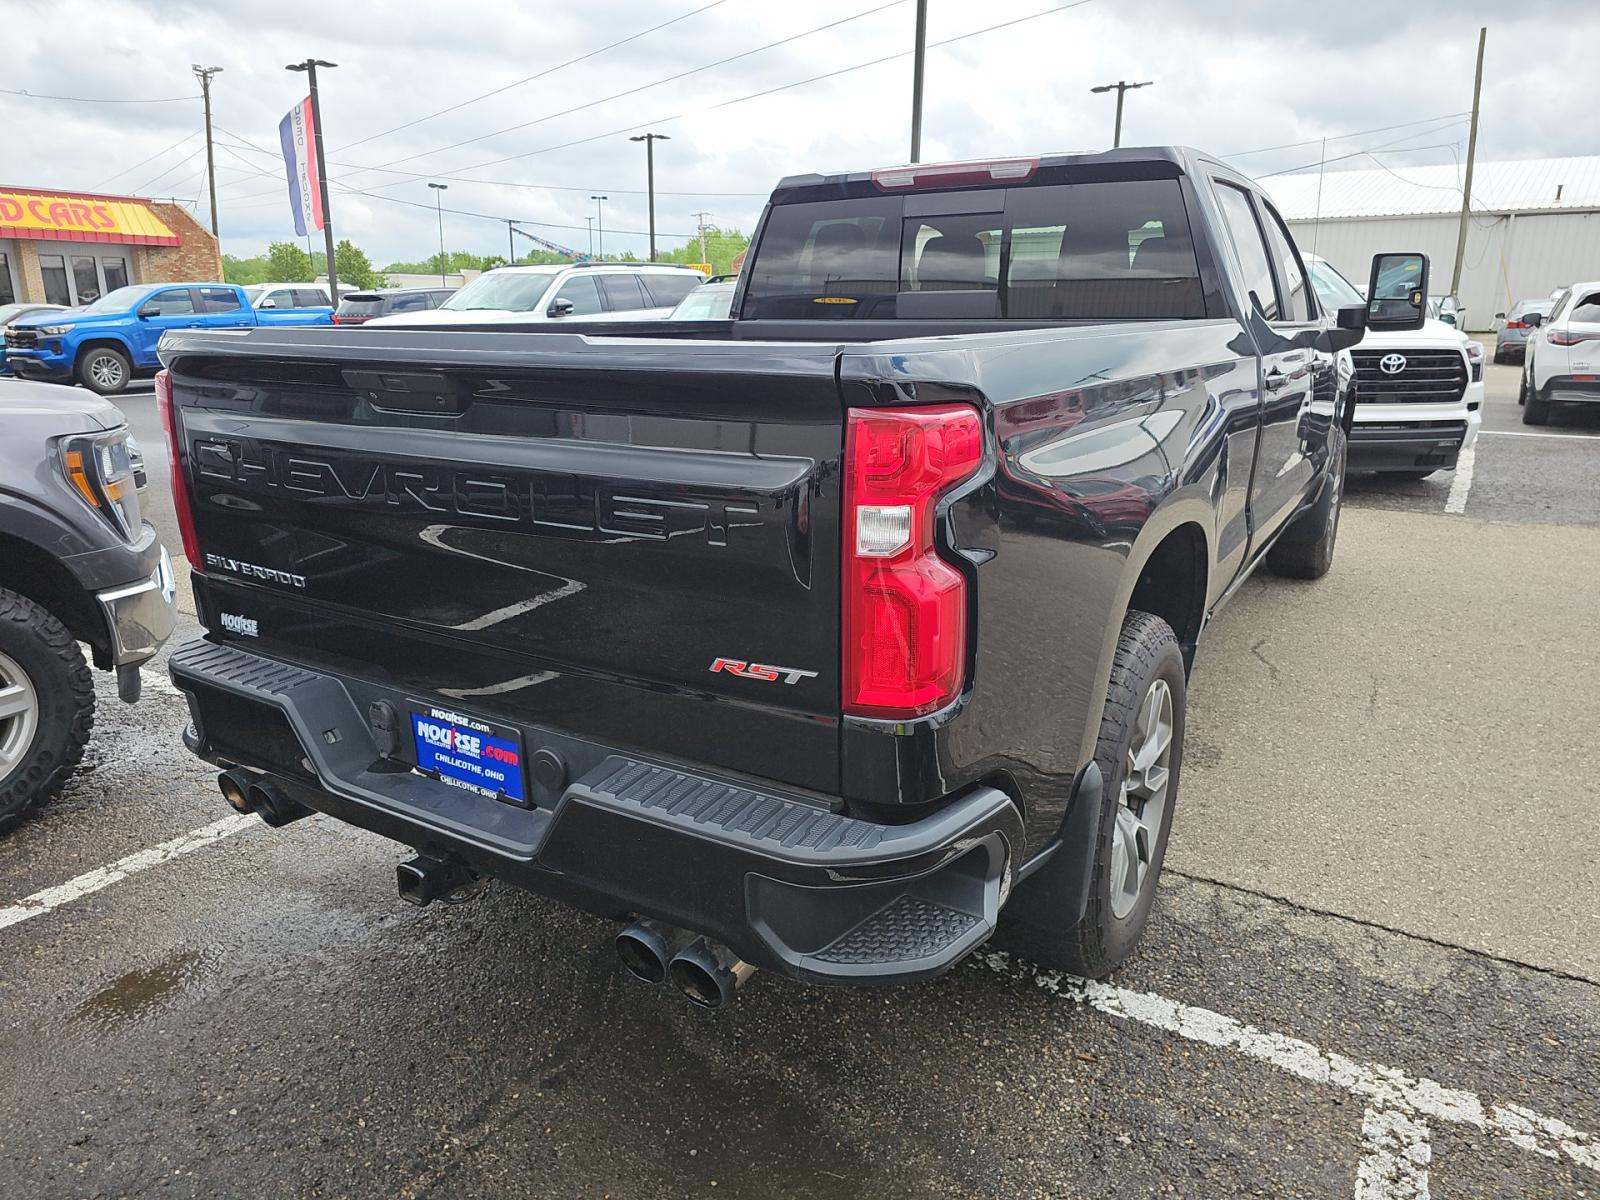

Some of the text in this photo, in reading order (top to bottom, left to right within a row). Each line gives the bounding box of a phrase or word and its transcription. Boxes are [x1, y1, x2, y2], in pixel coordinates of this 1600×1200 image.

[27, 200, 116, 230] CARS
[194, 438, 759, 547] CHEVROLET
[206, 553, 307, 588] SILVERADO
[220, 612, 259, 634] NOURSE
[709, 657, 820, 685] RST
[430, 707, 490, 733] NOURSE.com
[435, 752, 505, 782] CHILLICOTHE, OHIO
[480, 787, 498, 800] OHIO
